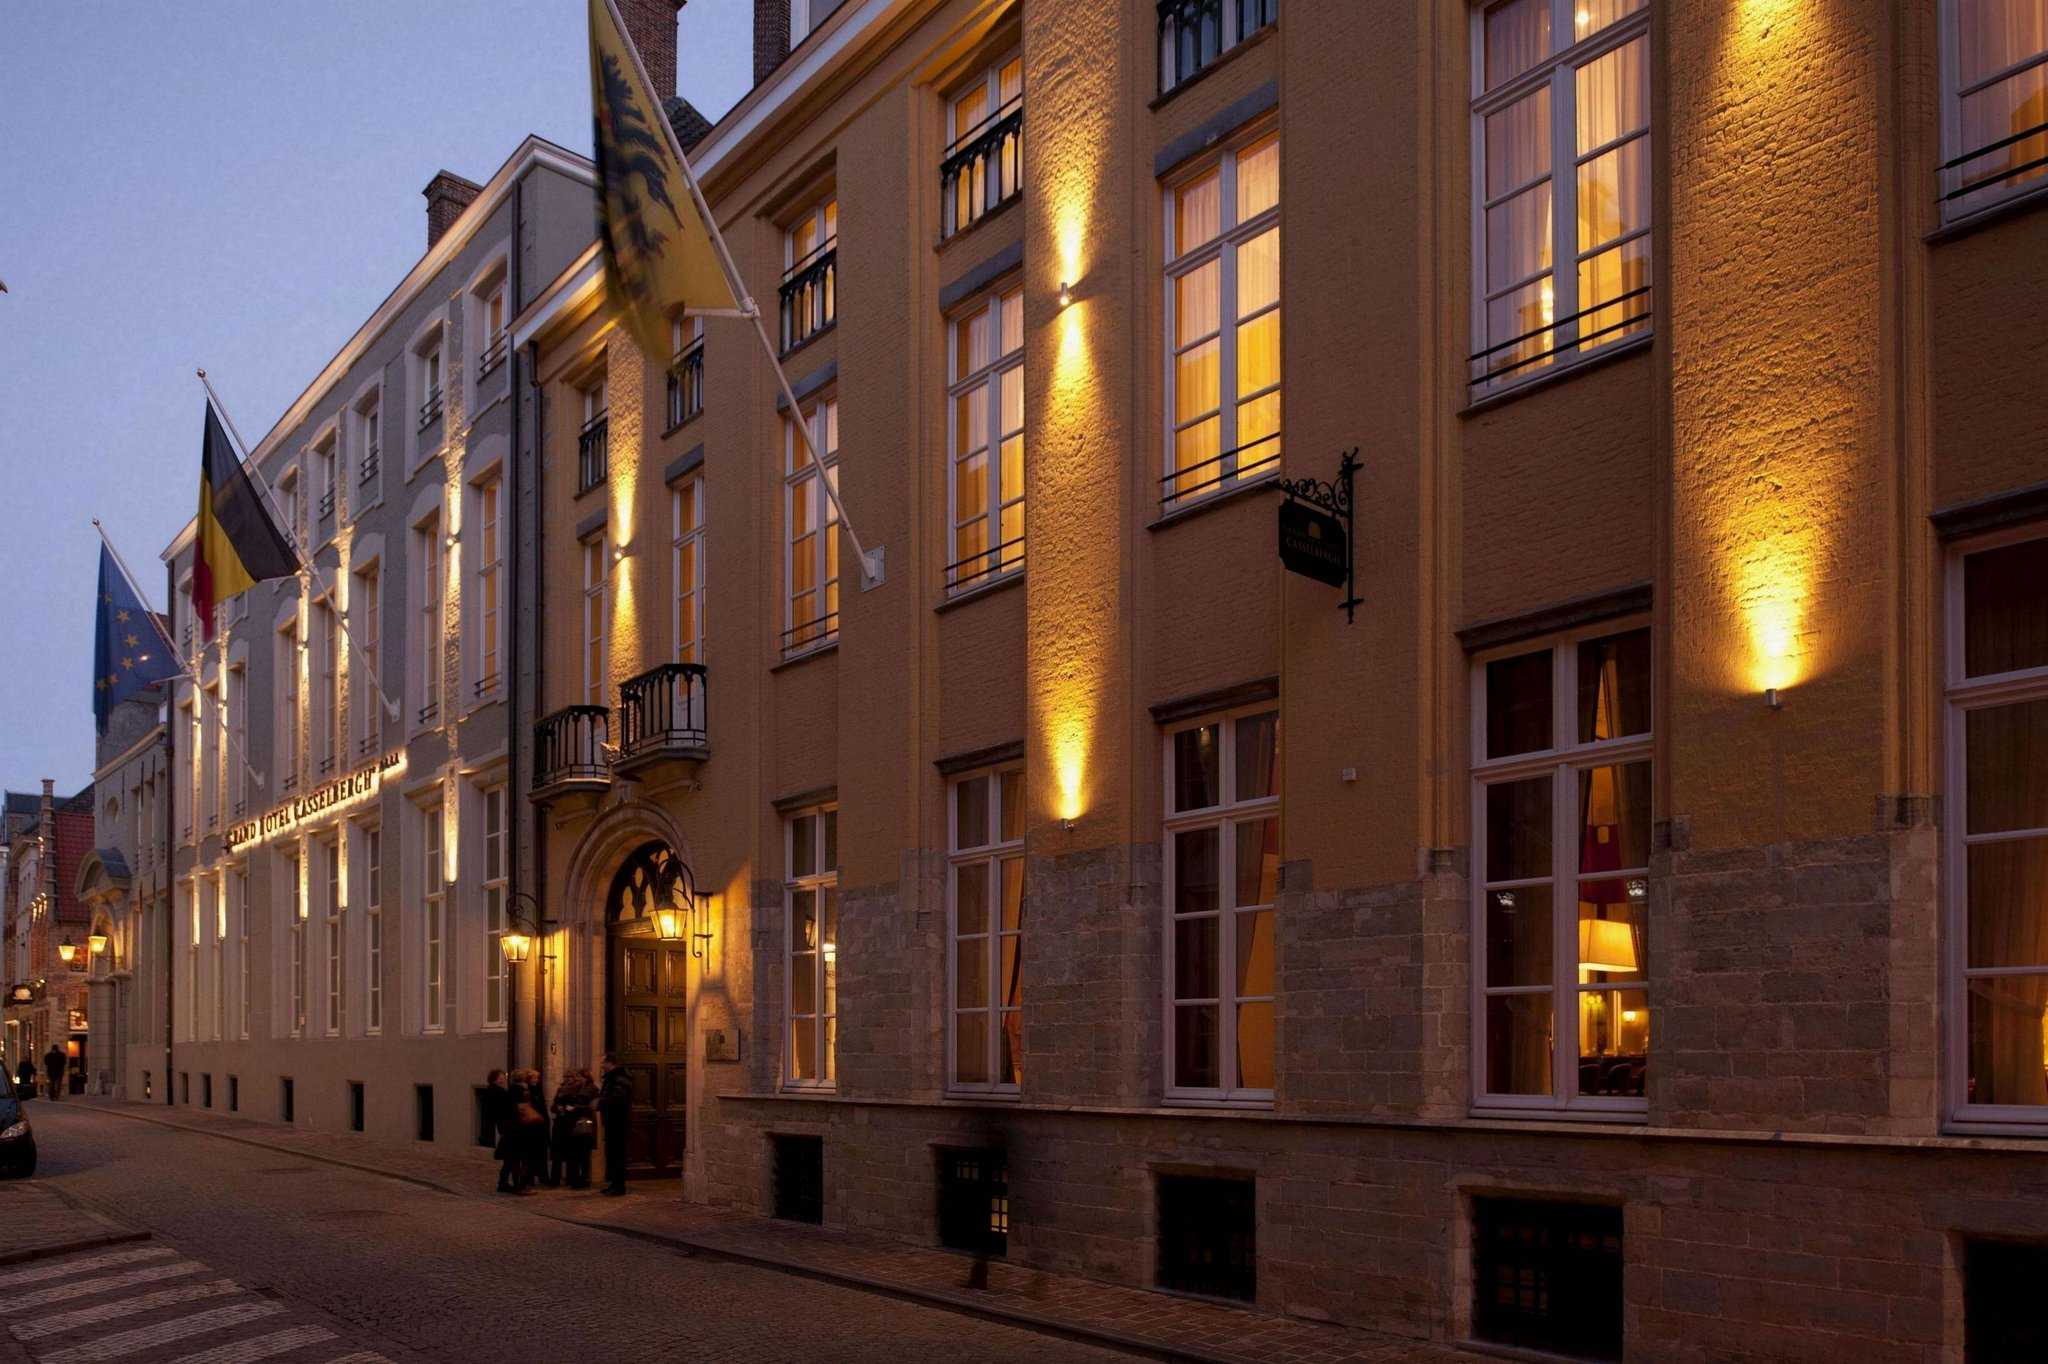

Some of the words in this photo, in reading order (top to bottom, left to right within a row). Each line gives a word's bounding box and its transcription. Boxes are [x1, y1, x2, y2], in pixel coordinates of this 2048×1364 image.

[226, 821, 256, 848] GRAND
[259, 807, 290, 836] HOTEL
[294, 769, 372, 820] CASSELBERGH
